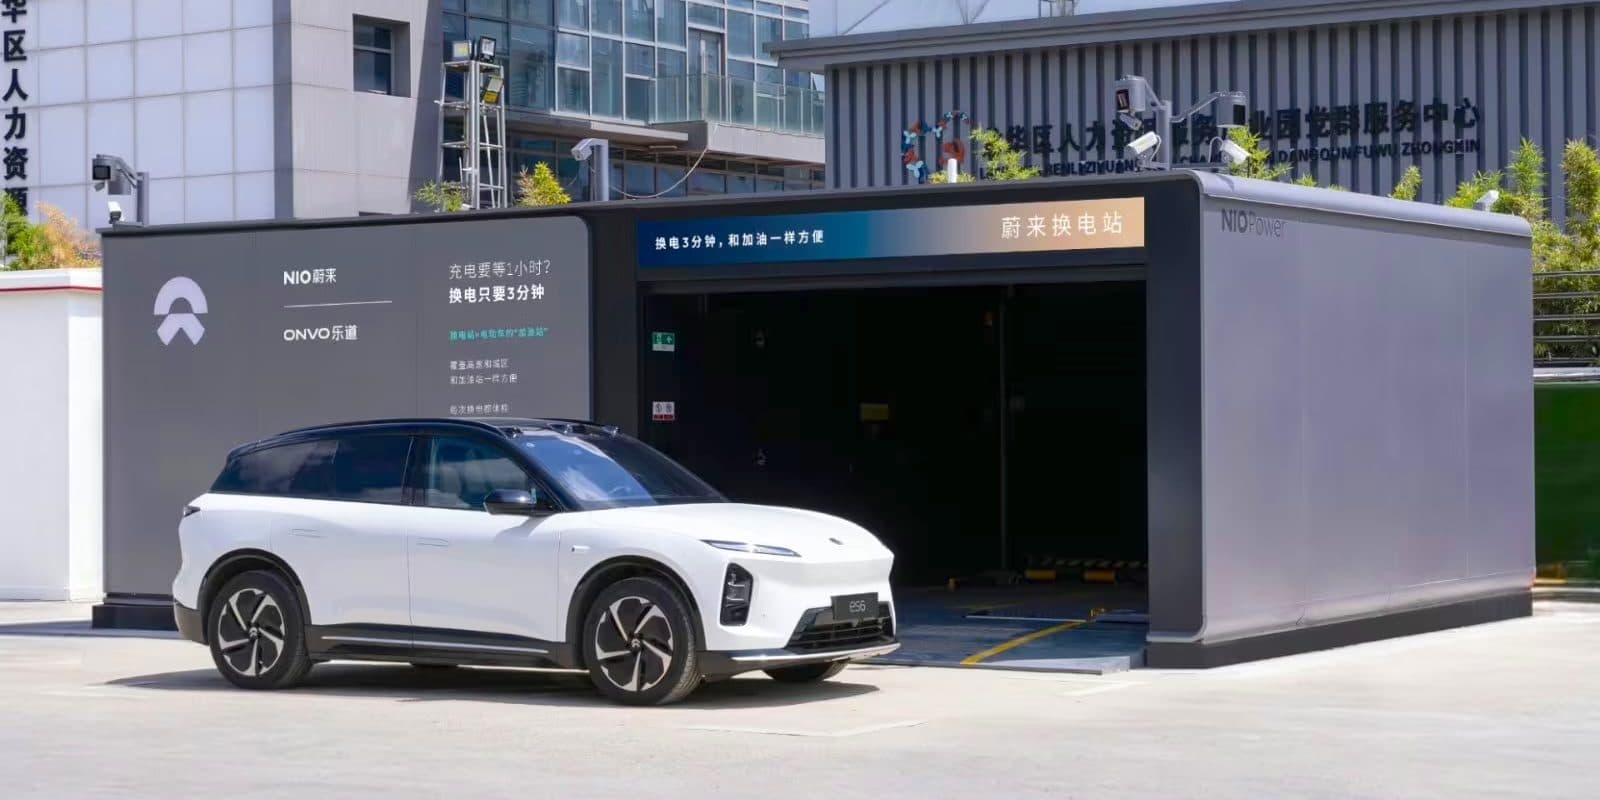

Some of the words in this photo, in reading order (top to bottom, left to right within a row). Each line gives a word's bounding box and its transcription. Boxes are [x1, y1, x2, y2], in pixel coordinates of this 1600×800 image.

[1001, 210, 1123, 239] 蔚来换电站
[449, 283, 545, 304] 换电只要3分钟
